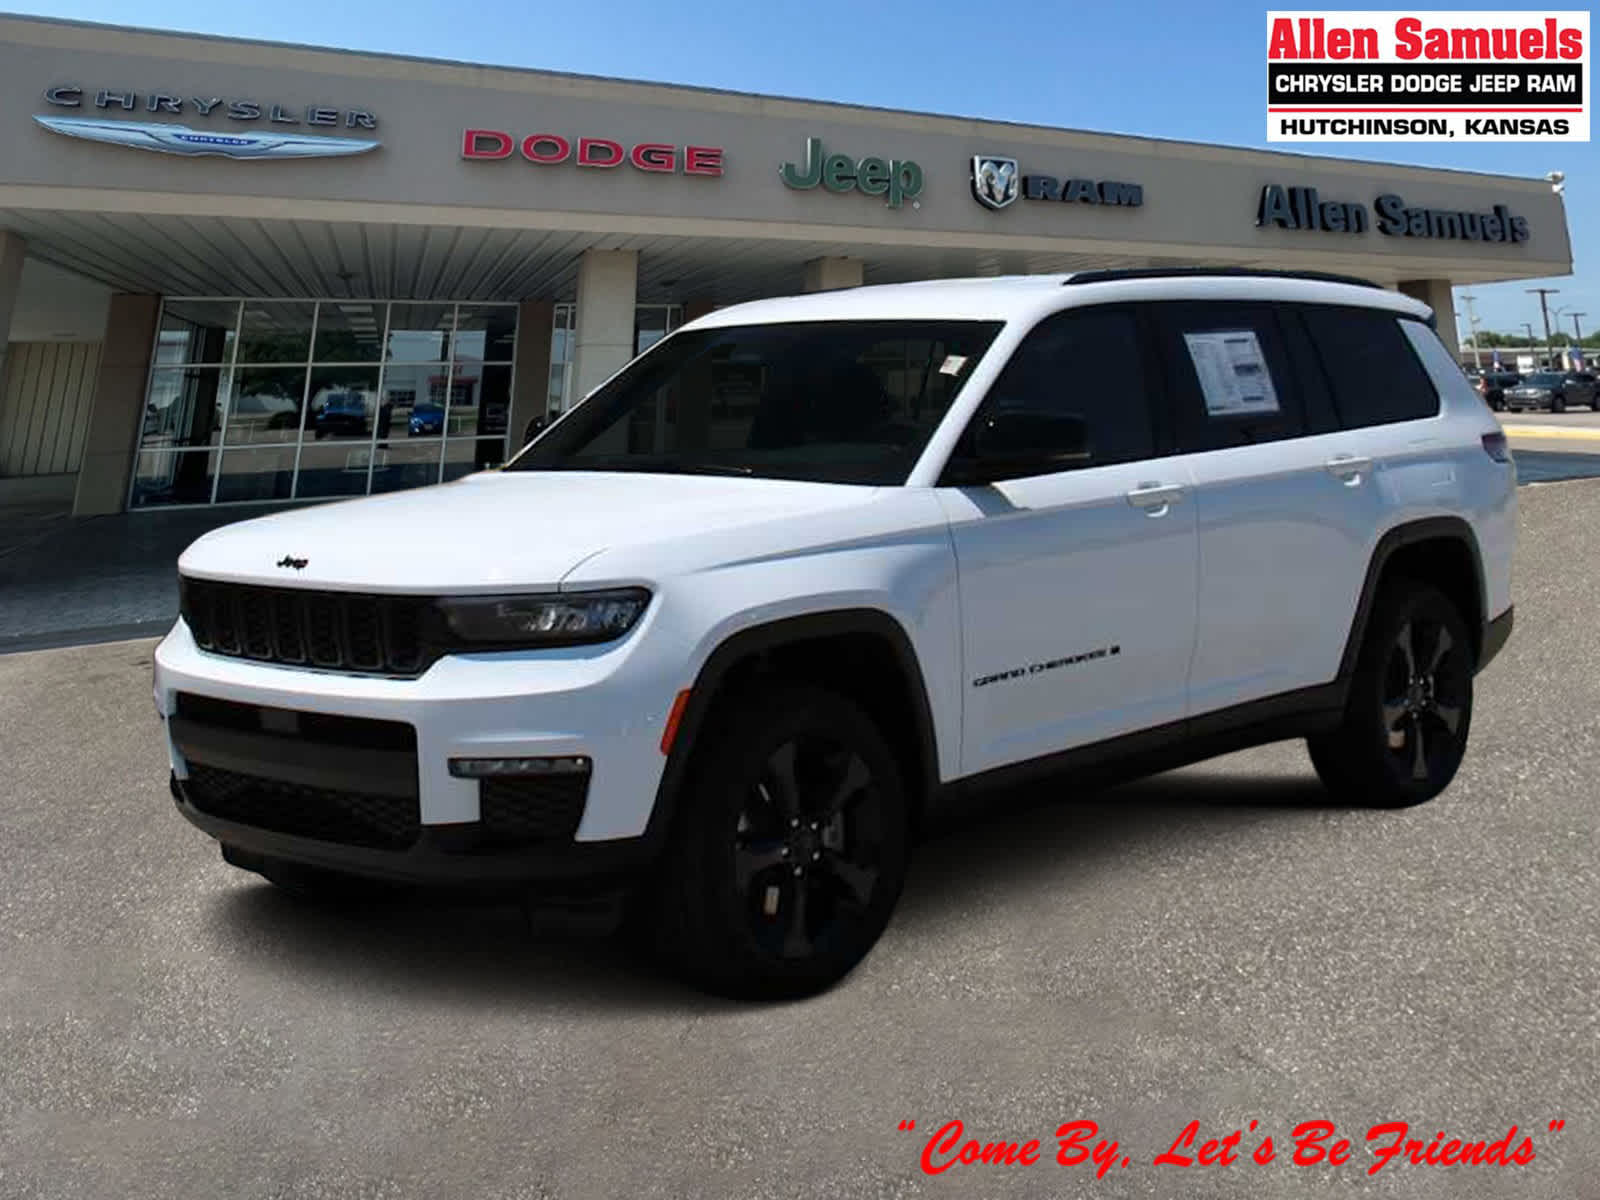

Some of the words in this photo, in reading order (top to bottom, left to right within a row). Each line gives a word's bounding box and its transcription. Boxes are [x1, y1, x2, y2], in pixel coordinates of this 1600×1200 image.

[44, 86, 378, 128] CHRYSLER
[461, 129, 725, 177] DODGE
[779, 137, 924, 208] Jeep
[1023, 175, 1144, 207] RAM
[1256, 184, 1368, 234] Allen
[1374, 194, 1531, 244] Samuels
[276, 554, 309, 571] Jeep
[973, 667, 1025, 687] GRAND
